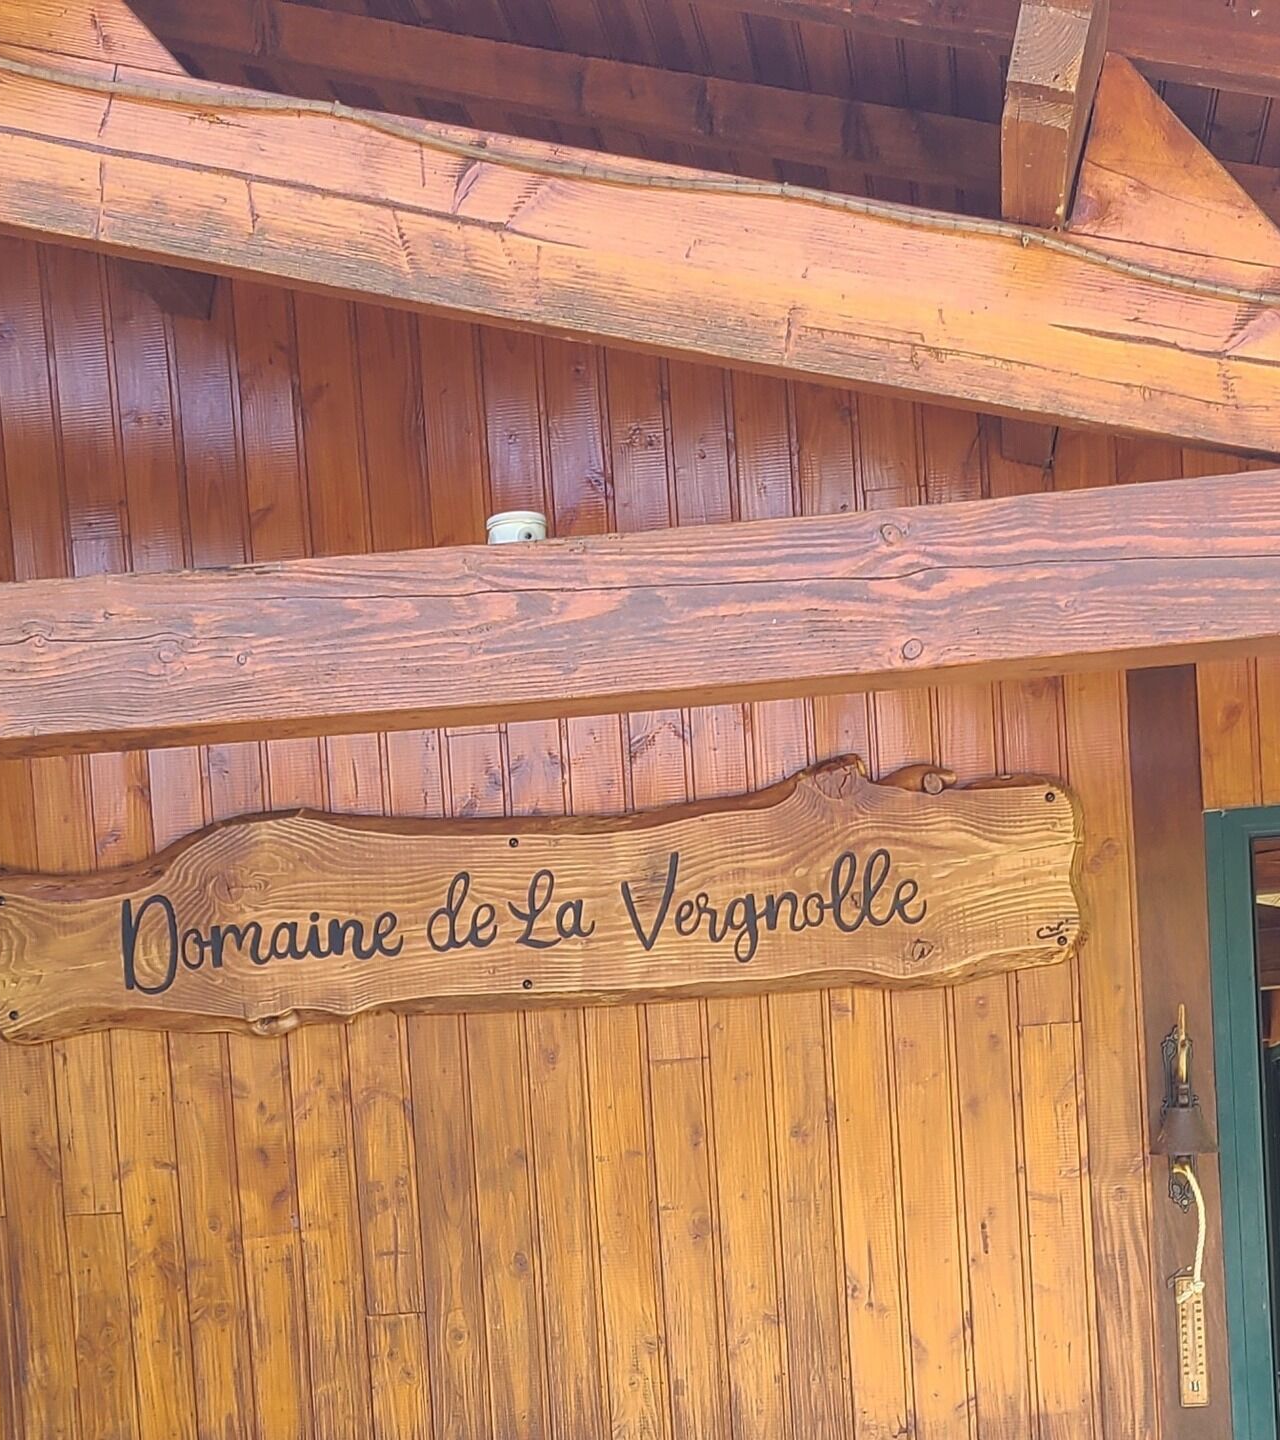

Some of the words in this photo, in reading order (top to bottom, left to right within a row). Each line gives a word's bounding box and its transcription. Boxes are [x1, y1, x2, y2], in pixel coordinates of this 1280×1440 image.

[121, 894, 404, 995] Domaine
[426, 871, 498, 953] de
[508, 869, 595, 949] La
[621, 848, 927, 963] Vergnolle
